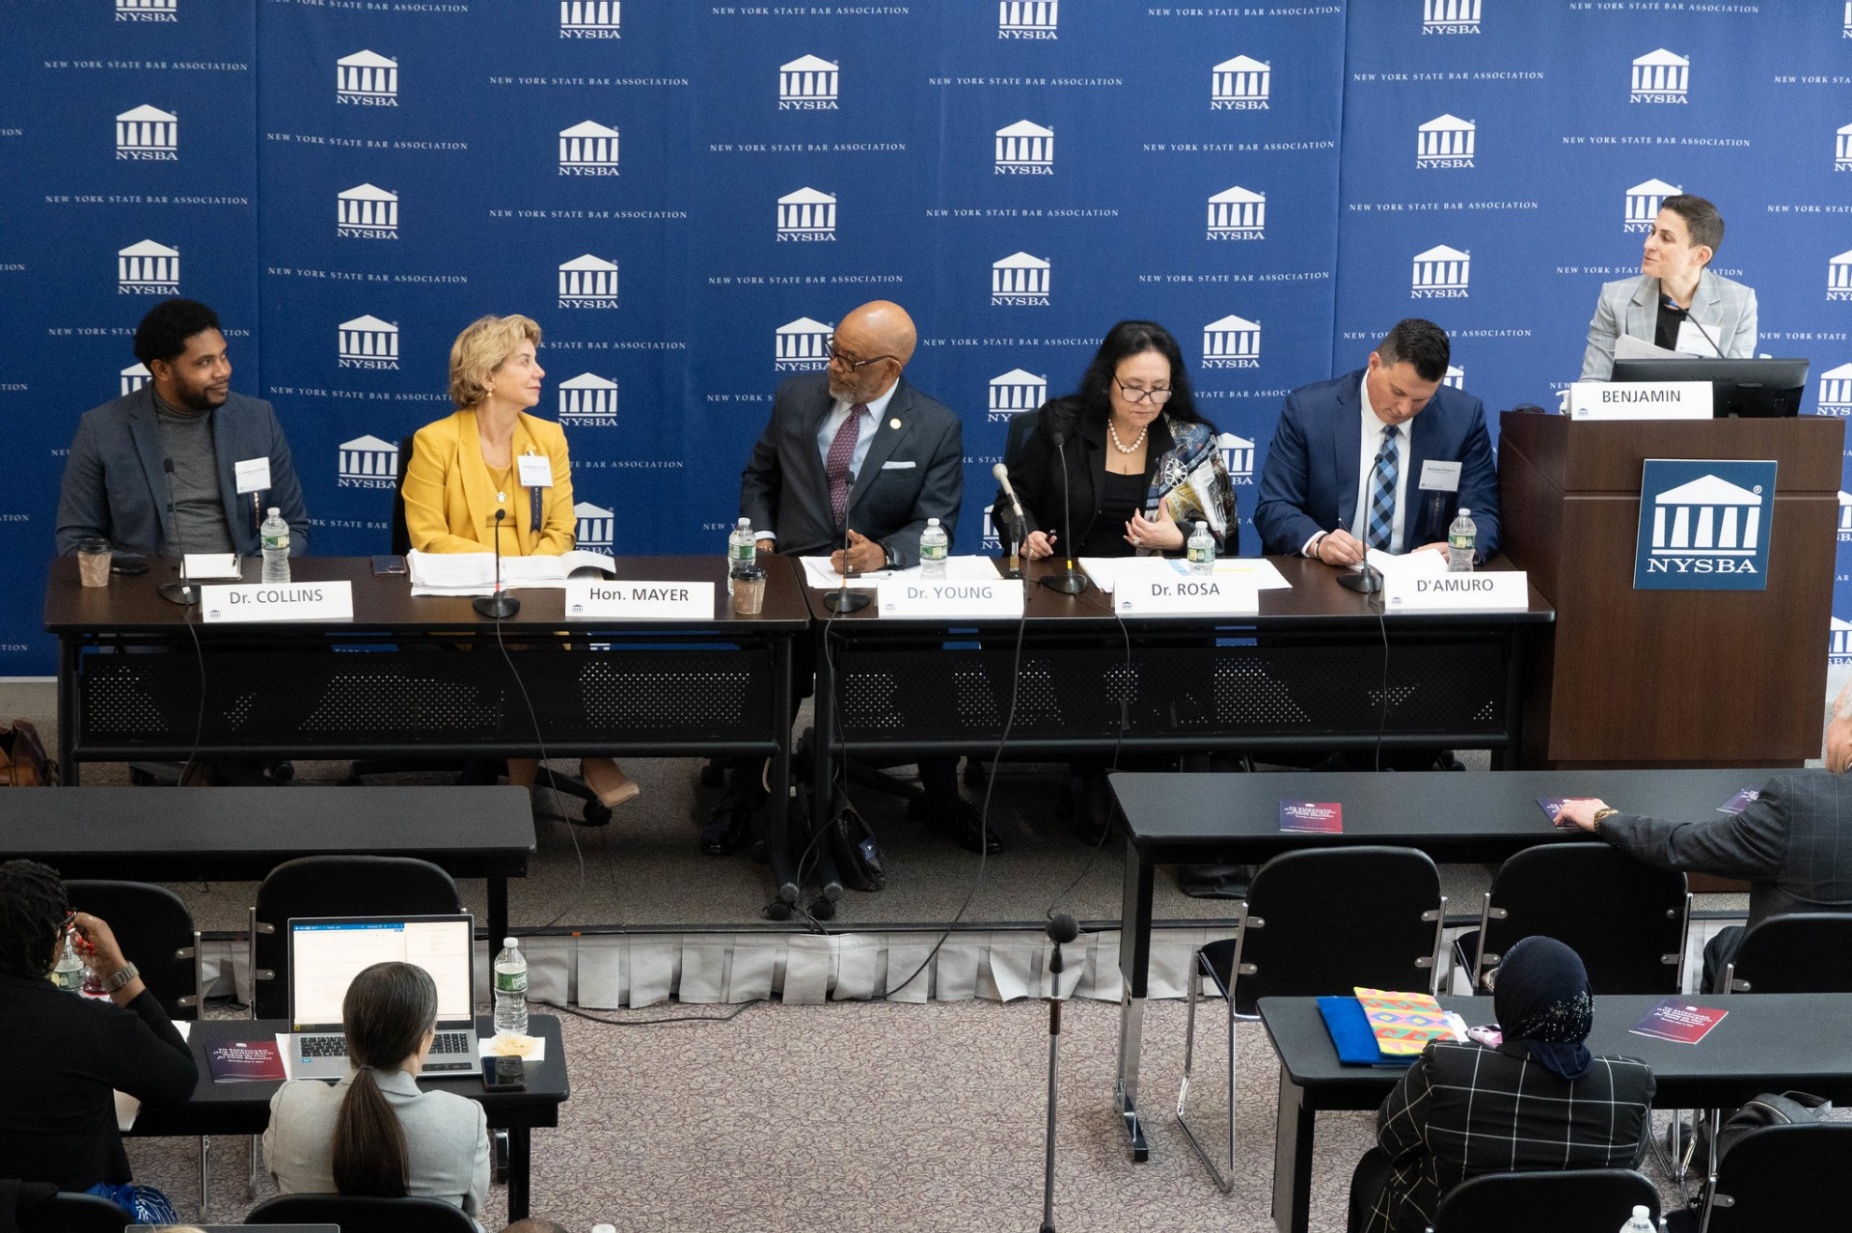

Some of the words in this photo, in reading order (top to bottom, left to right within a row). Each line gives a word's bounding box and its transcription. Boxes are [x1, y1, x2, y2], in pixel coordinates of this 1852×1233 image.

[711, 6, 736, 15] NEW
[740, 6, 770, 16] YORK
[773, 6, 806, 16] STATE
[810, 6, 832, 15] BAR
[835, 6, 910, 15] ASSOCIATION
[1147, 7, 1171, 17] NEW
[1175, 8, 1204, 17] YORK
[1207, 8, 1240, 17] STATE
[1243, 7, 1265, 17] BAR
[1268, 5, 1342, 17] ASSOCIATION
[1569, 2, 1593, 11] NEW
[1596, 2, 1625, 10] YORK
[1628, 2, 1660, 11] STATE
[1664, 2, 1684, 11] BAR
[1688, 3, 1759, 14] ASSOCIATION
[115, 13, 178, 22] NYSBA
[559, 30, 621, 38] NYSBA
[998, 30, 1058, 39] NYSBA
[1421, 25, 1481, 35] NYSBA
[43, 60, 69, 69] NEW
[72, 60, 103, 69] YORK
[107, 60, 141, 69] STATE
[145, 60, 168, 70] BAR
[171, 61, 248, 71] ASSOCIATION
[489, 76, 514, 85] NEW
[517, 76, 547, 85] YORK
[551, 77, 585, 86] STATE
[588, 77, 610, 86] BAR
[614, 77, 689, 86] ASSOCIATION
[928, 77, 952, 86] NEW
[956, 77, 985, 85] YORK
[988, 77, 1021, 86] STATE
[1025, 77, 1047, 86] BAR
[1050, 77, 1123, 86] ASSOCIATION
[1353, 73, 1377, 82] NEW
[1380, 73, 1409, 82] YORK
[1412, 72, 1444, 81] STATE
[1448, 71, 1469, 80] BAR
[1472, 71, 1545, 80] ASSOCIATION
[1774, 75, 1797, 84] NEW
[1801, 75, 1829, 84] YORK
[336, 95, 399, 107] NYSBA
[1629, 94, 1689, 104] NYSBA
[778, 101, 839, 110] NYSBA
[1210, 101, 1270, 110] NYSBA
[266, 132, 291, 141] NEW
[295, 134, 326, 145] YORK
[329, 137, 363, 148] STATE
[366, 139, 389, 149] BAR
[393, 141, 468, 151] ASSOCIATION
[1143, 143, 1166, 152] NEW
[1170, 143, 1199, 152] YORK
[1202, 143, 1235, 152] STATE
[1238, 143, 1259, 152] BAR
[1262, 140, 1335, 151] ASSOCIATION
[1562, 136, 1586, 144] NEW
[1589, 136, 1617, 145] YORK
[1620, 136, 1652, 145] STATE
[1656, 136, 1677, 145] BAR
[1680, 137, 1751, 147] ASSOCIATION
[709, 143, 734, 152] NEW
[737, 143, 767, 152] YORK
[770, 143, 803, 152] STATE
[807, 143, 829, 152] BAR
[832, 142, 906, 152] ASSOCIATION
[115, 151, 179, 161] NYSBA
[1416, 159, 1475, 169] NYSBA
[558, 167, 620, 175] NYSBA
[994, 166, 1054, 174] NYSBA
[1349, 203, 1372, 212] NEW
[1376, 203, 1404, 212] YORK
[1407, 202, 1439, 211] STATE
[1443, 201, 1464, 210] BAR
[1467, 201, 1539, 210] ASSOCIATION
[1767, 204, 1790, 213] NEW
[1794, 204, 1821, 213] YORK
[489, 209, 513, 218] NEW
[517, 209, 547, 218] YORK
[550, 210, 584, 219] STATE
[587, 210, 609, 219] BAR
[613, 210, 688, 219] ASSOCIATION
[926, 209, 949, 217] NEW
[953, 208, 982, 217] YORK
[985, 208, 1018, 217] STATE
[1021, 209, 1043, 217] BAR
[1046, 208, 1119, 217] ASSOCIATION
[337, 228, 399, 239] NYSBA
[776, 233, 837, 241] NYSBA
[1206, 231, 1265, 240] NYSBA
[267, 266, 293, 276] NEW
[296, 268, 327, 279] YORK
[330, 271, 364, 281] STATE
[367, 273, 389, 283] BAR
[393, 274, 468, 284] ASSOCIATION
[1556, 266, 1579, 274] NEW
[1583, 266, 1611, 274] YORK
[708, 276, 732, 285] NEW
[736, 276, 765, 285] YORK
[768, 276, 801, 284] STATE
[805, 276, 826, 284] BAR
[830, 274, 903, 284] ASSOCIATION
[1138, 274, 1162, 283] NEW
[1165, 274, 1194, 283] YORK
[1198, 274, 1230, 283] STATE
[1233, 274, 1254, 283] BAR
[1258, 271, 1330, 282] ASSOCIATION
[118, 286, 181, 295] NYSBA
[1410, 289, 1469, 298] NYSBA
[558, 300, 619, 308] NYSBA
[991, 297, 1051, 305] NYSBA
[1343, 331, 1367, 340] NEW
[1461, 329, 1532, 338] ASSOCIATION
[1759, 332, 1782, 341] NEW
[1785, 332, 1813, 340] YORK
[1816, 332, 1847, 341] STATE
[550, 341, 584, 350] STATE
[587, 341, 609, 350] BAR
[612, 341, 686, 350] ASSOCIATION
[923, 338, 946, 347] NEW
[950, 338, 979, 347] YORK
[982, 337, 1015, 346] STATE
[1018, 338, 1040, 346] BAR
[338, 359, 400, 370] NYSBA
[1201, 360, 1260, 368] NYSBA
[270, 385, 294, 395] NEW
[298, 387, 328, 397] YORK
[331, 389, 365, 400] STATE
[368, 391, 391, 401] BAR
[706, 393, 730, 402] NEW
[734, 393, 763, 402] YORK
[1229, 390, 1250, 399] BAR
[1602, 390, 1681, 403] BENJAMIN
[557, 418, 618, 427] NYSBA
[585, 460, 607, 469] BAR
[610, 460, 684, 469] ASSOCIATION
[337, 478, 398, 489] NYSBA
[329, 519, 363, 529] STATE
[366, 521, 389, 530] BAR
[702, 522, 726, 531] NEW
[1646, 558, 1757, 573] NYSBA
[1151, 583, 1171, 597] Dr.
[1177, 583, 1220, 596] ROSA
[1417, 578, 1493, 592] D'AMURO
[229, 591, 251, 604] Dr.
[256, 588, 323, 604] COLLINS
[590, 588, 626, 601] Hon.
[633, 588, 689, 601] MAYER
[907, 587, 929, 600] Dr.
[934, 587, 993, 600] YOUNG
